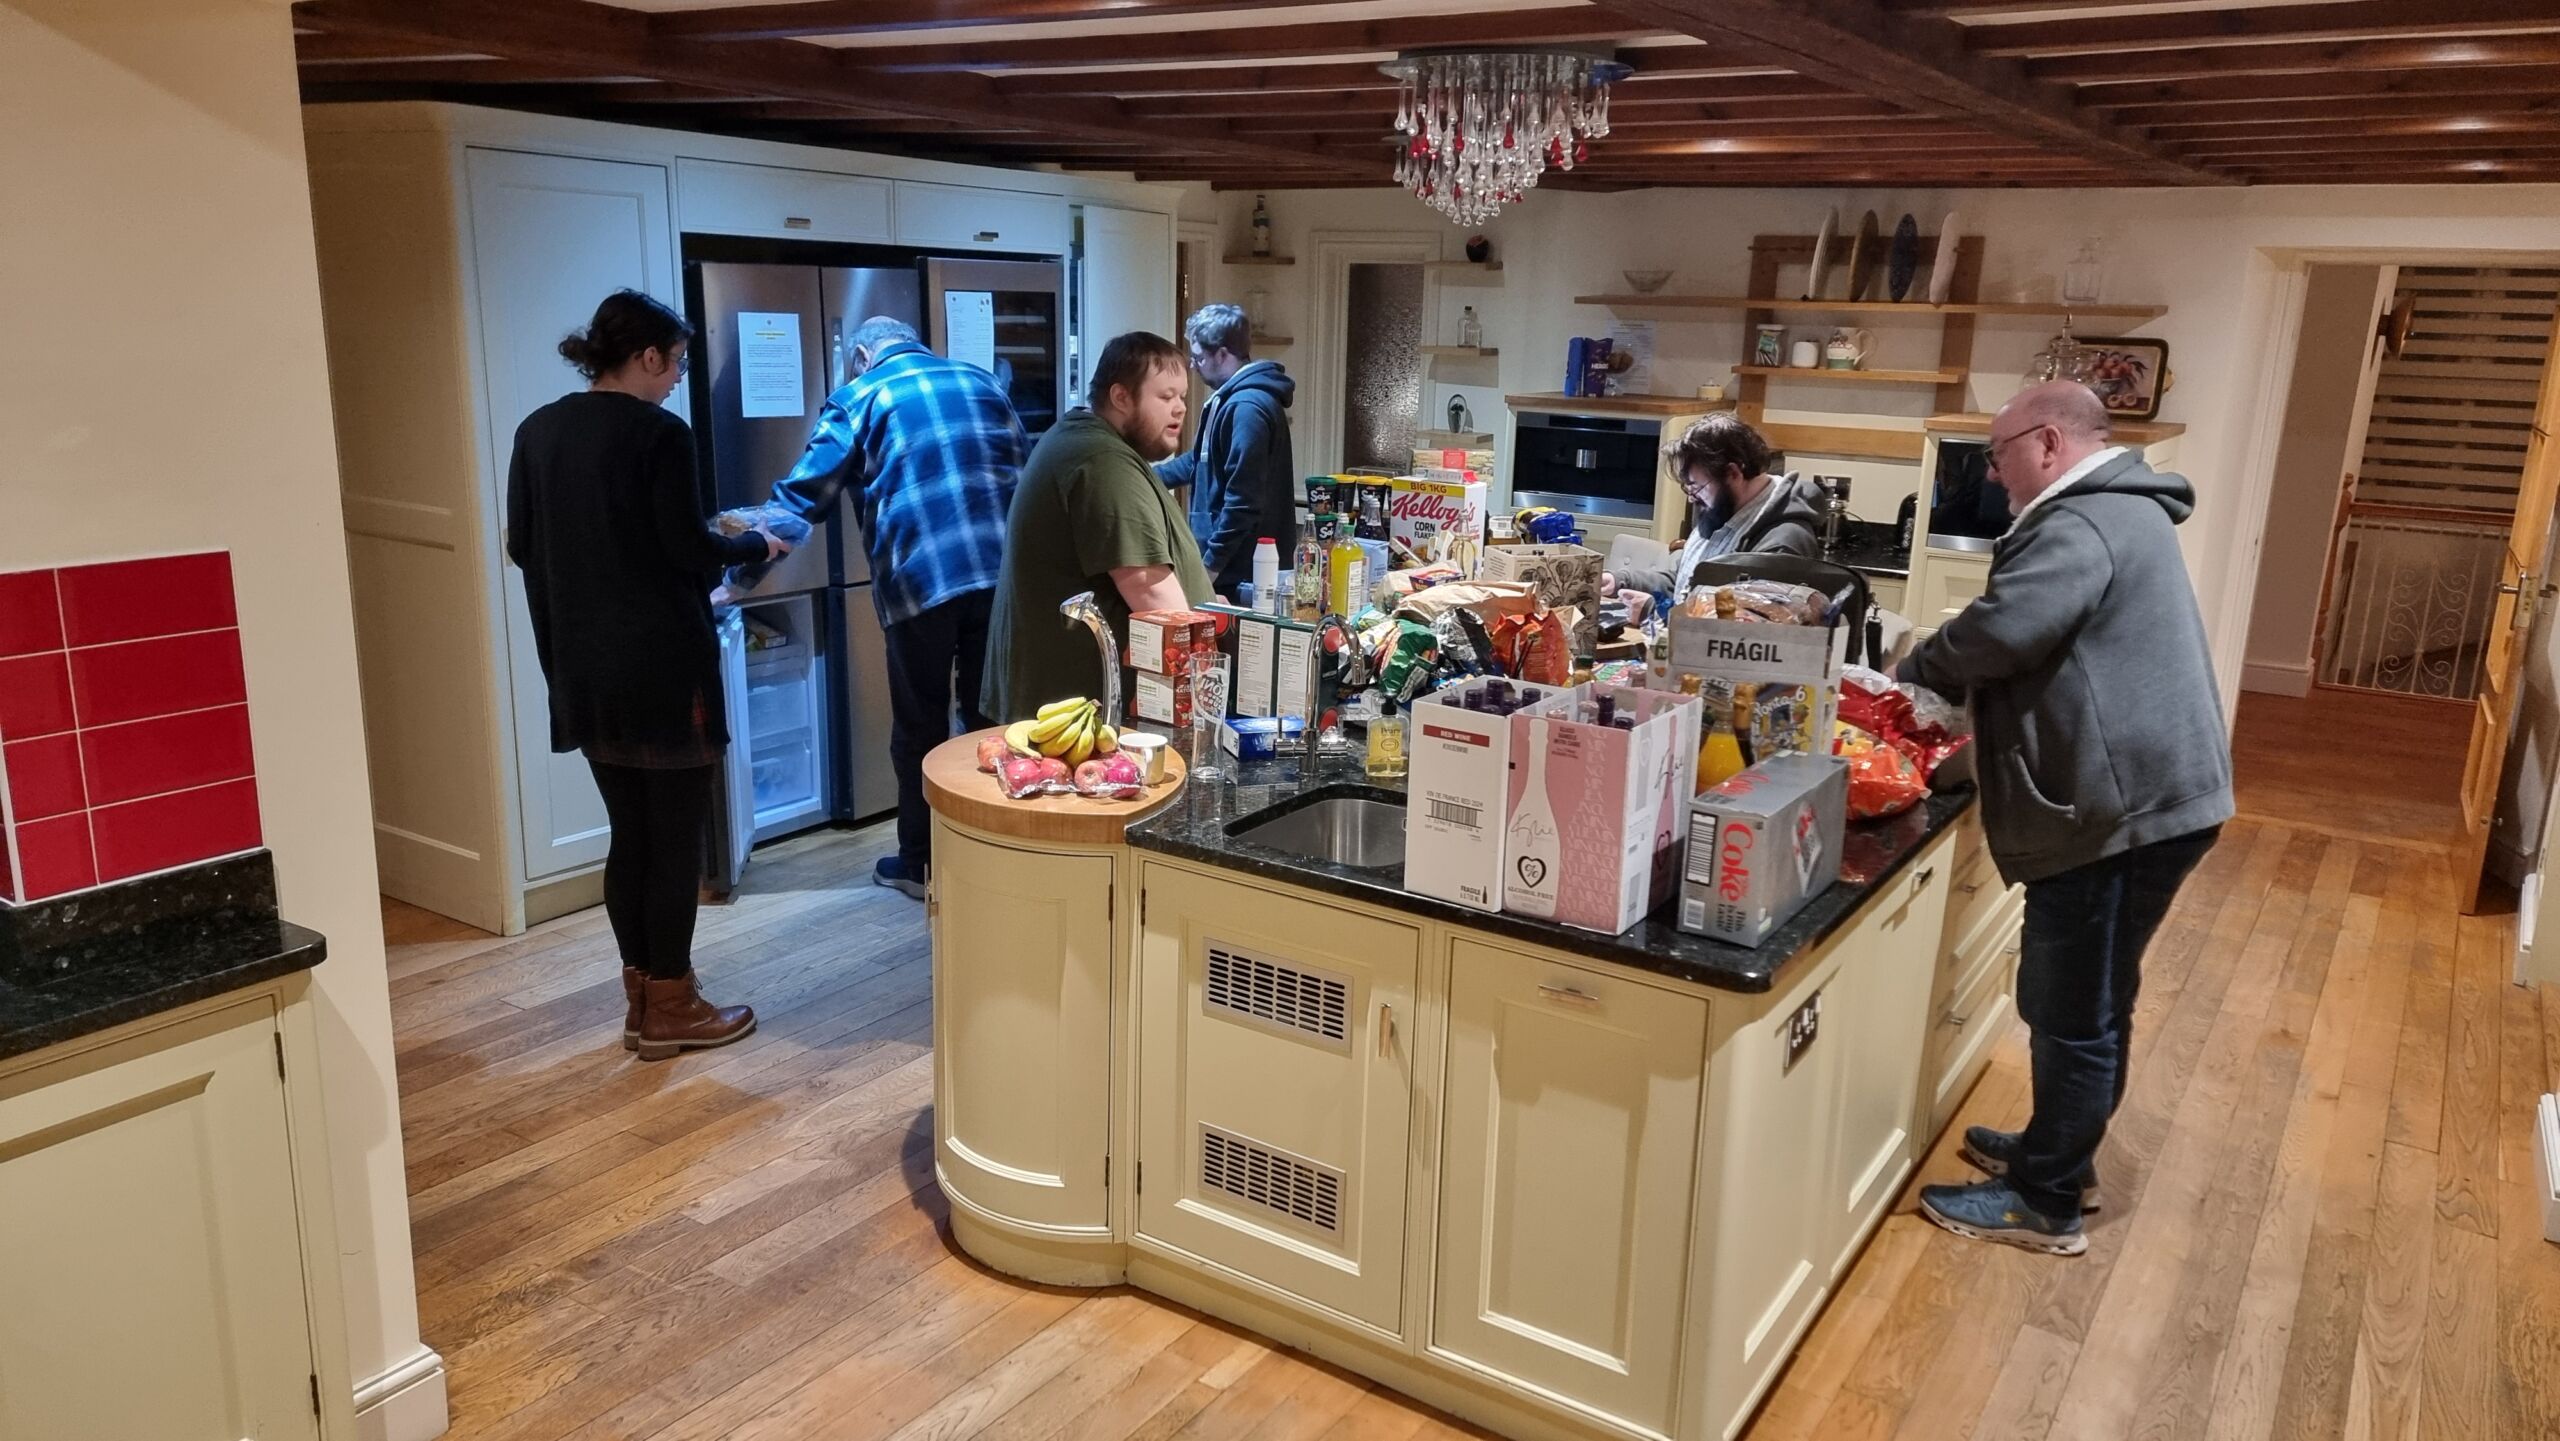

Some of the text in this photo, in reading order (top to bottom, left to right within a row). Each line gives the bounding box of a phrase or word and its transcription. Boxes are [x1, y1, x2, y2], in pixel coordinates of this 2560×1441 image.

[1410, 481, 1447, 494] BIG 1KG
[1414, 521, 1436, 533] CORN
[1707, 637, 1783, 663] FRÁGIL
[1795, 686, 1808, 702] 6
[1440, 730, 1454, 738] RED
[1719, 822, 1754, 902] Coke
